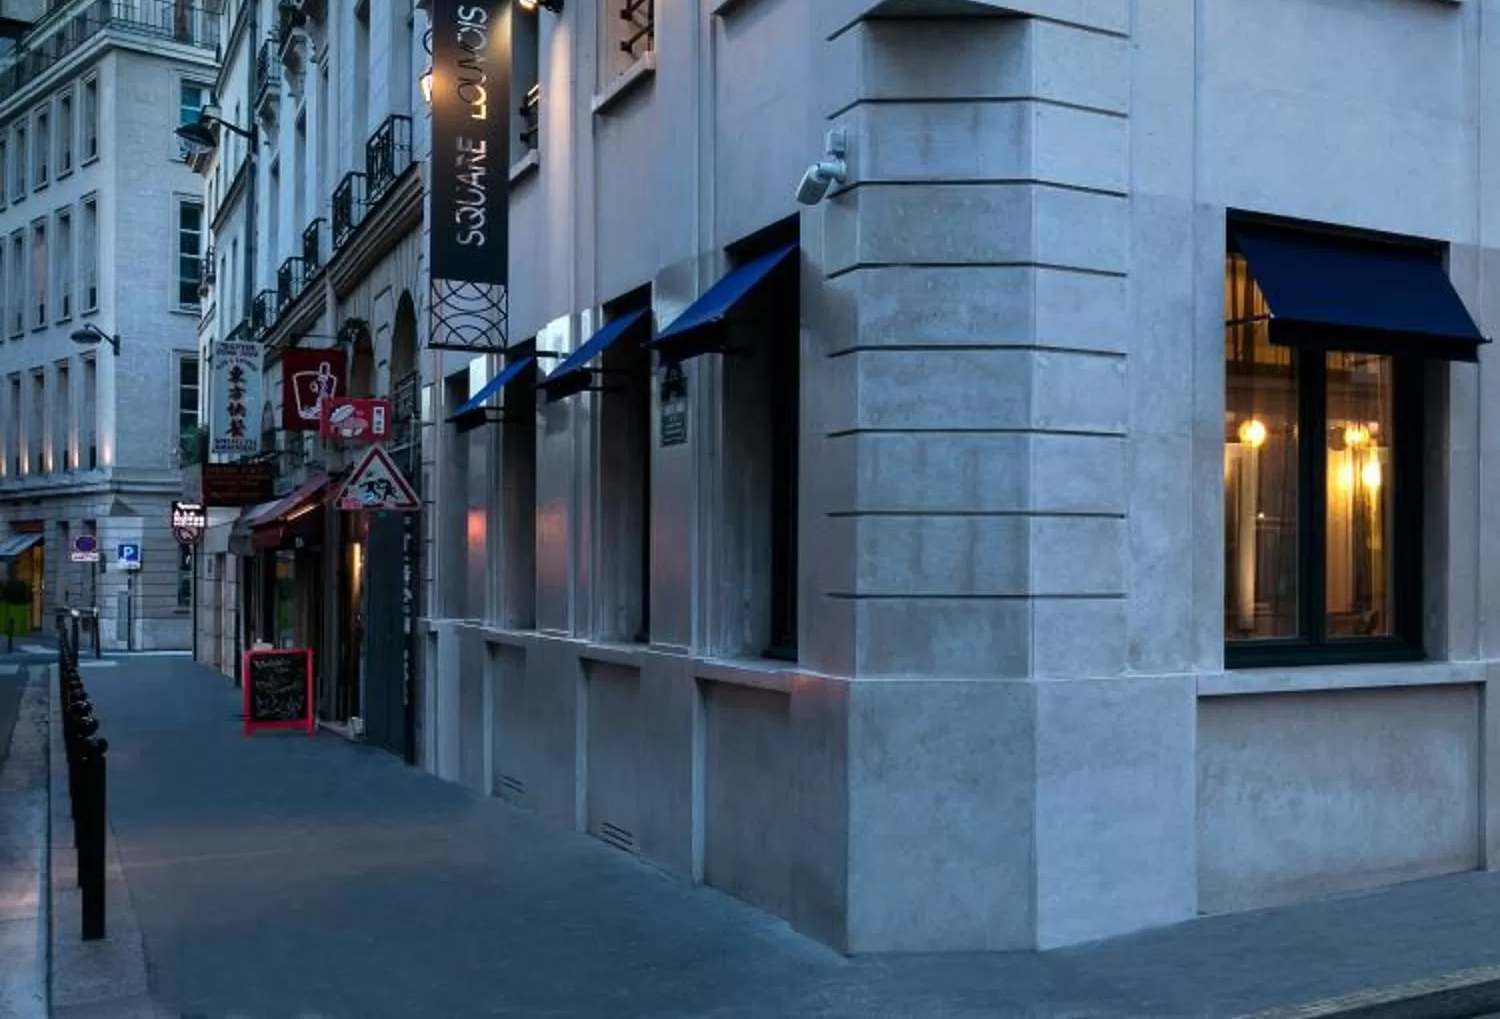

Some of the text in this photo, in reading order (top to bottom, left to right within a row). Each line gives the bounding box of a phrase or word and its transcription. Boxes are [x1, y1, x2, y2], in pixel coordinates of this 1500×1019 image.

[456, 4, 488, 246] SQUARE LOUVOIS
[123, 546, 135, 561] P
